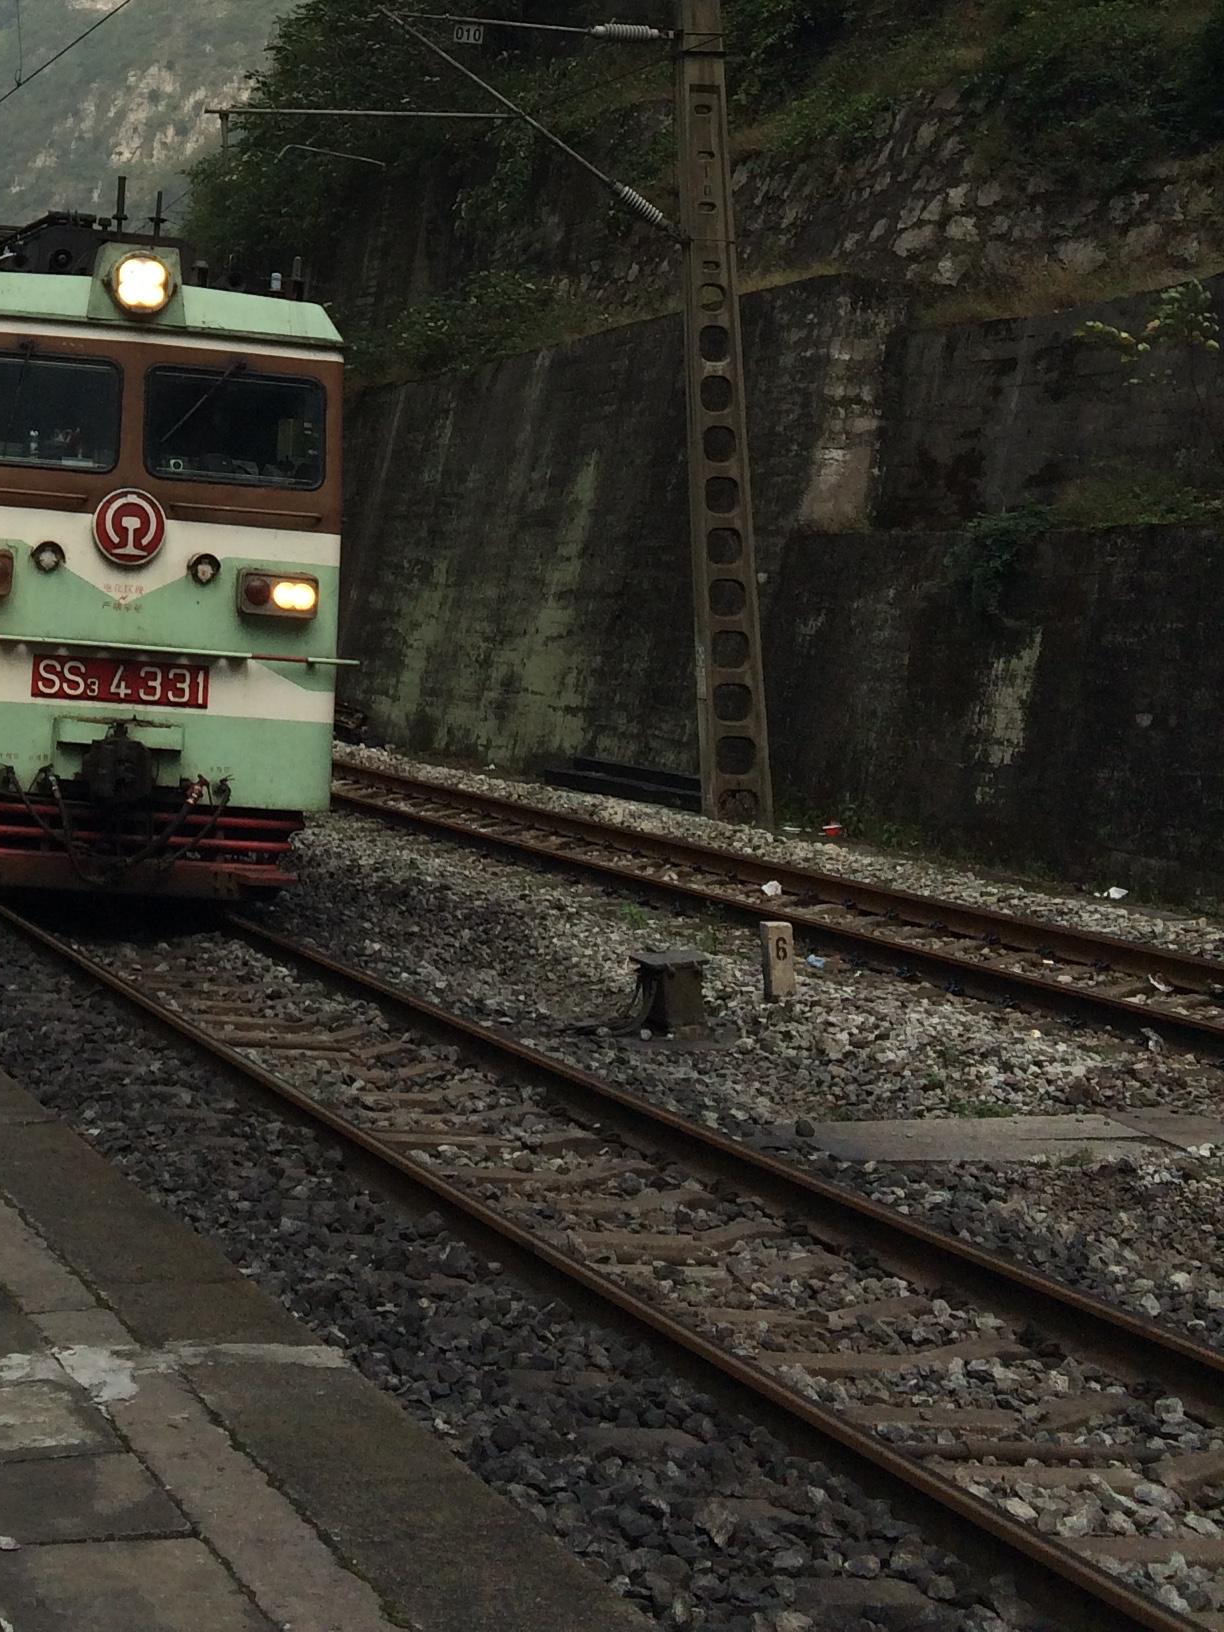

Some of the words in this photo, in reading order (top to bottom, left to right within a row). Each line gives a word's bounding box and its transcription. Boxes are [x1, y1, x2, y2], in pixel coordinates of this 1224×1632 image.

[455, 26, 482, 42] 010
[109, 664, 205, 705] 4331
[774, 936, 789, 962] 6
